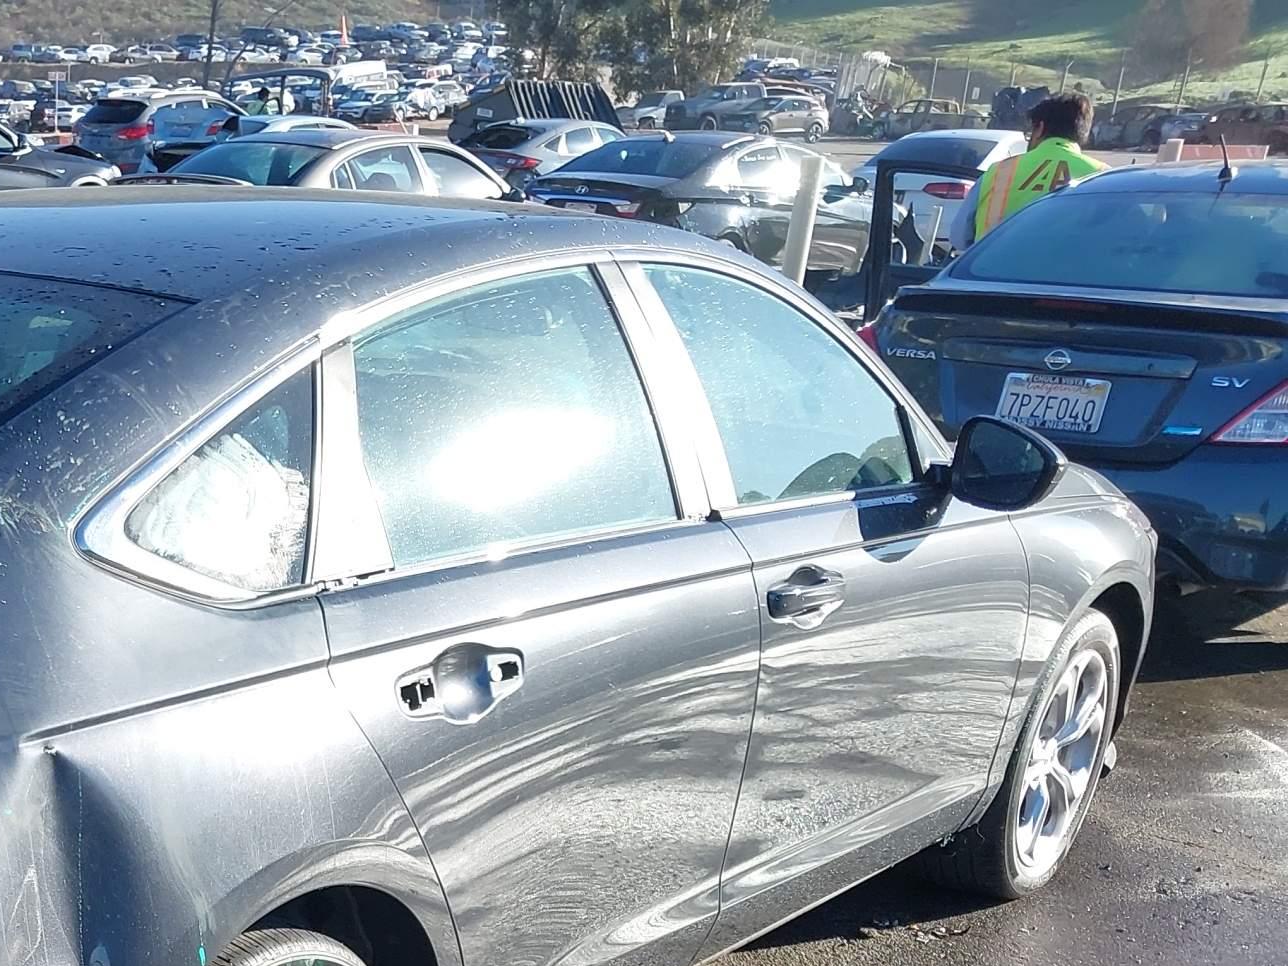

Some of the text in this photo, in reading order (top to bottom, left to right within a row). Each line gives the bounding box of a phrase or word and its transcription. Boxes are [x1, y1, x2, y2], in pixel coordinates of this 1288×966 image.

[886, 347, 937, 360] VERSA
[1030, 374, 1060, 384] CHULA
[1211, 376, 1251, 388] SV
[1008, 392, 1096, 423] 7PZF040
[1045, 420, 1088, 432] NISSAN
